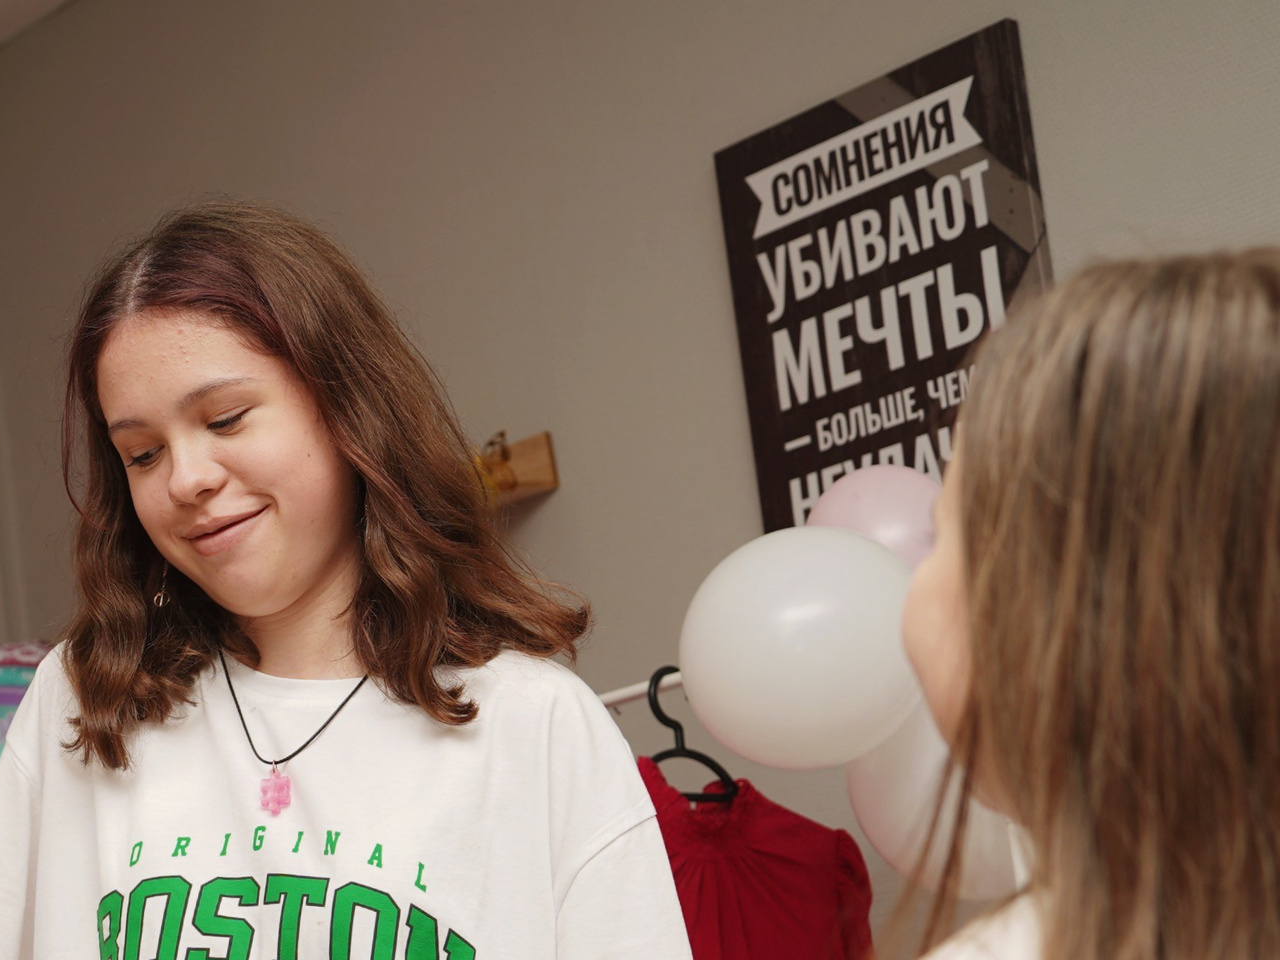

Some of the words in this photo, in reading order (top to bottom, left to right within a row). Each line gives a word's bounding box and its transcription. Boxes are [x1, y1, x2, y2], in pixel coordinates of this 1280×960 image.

[770, 99, 956, 217] СОМНЕНИЯ
[756, 159, 990, 324] УБИВАЮТ
[772, 245, 1007, 412] МЕЧТЫ
[816, 386, 925, 453] БОЛЬШЕ,
[129, 825, 427, 893] ORIGINAL
